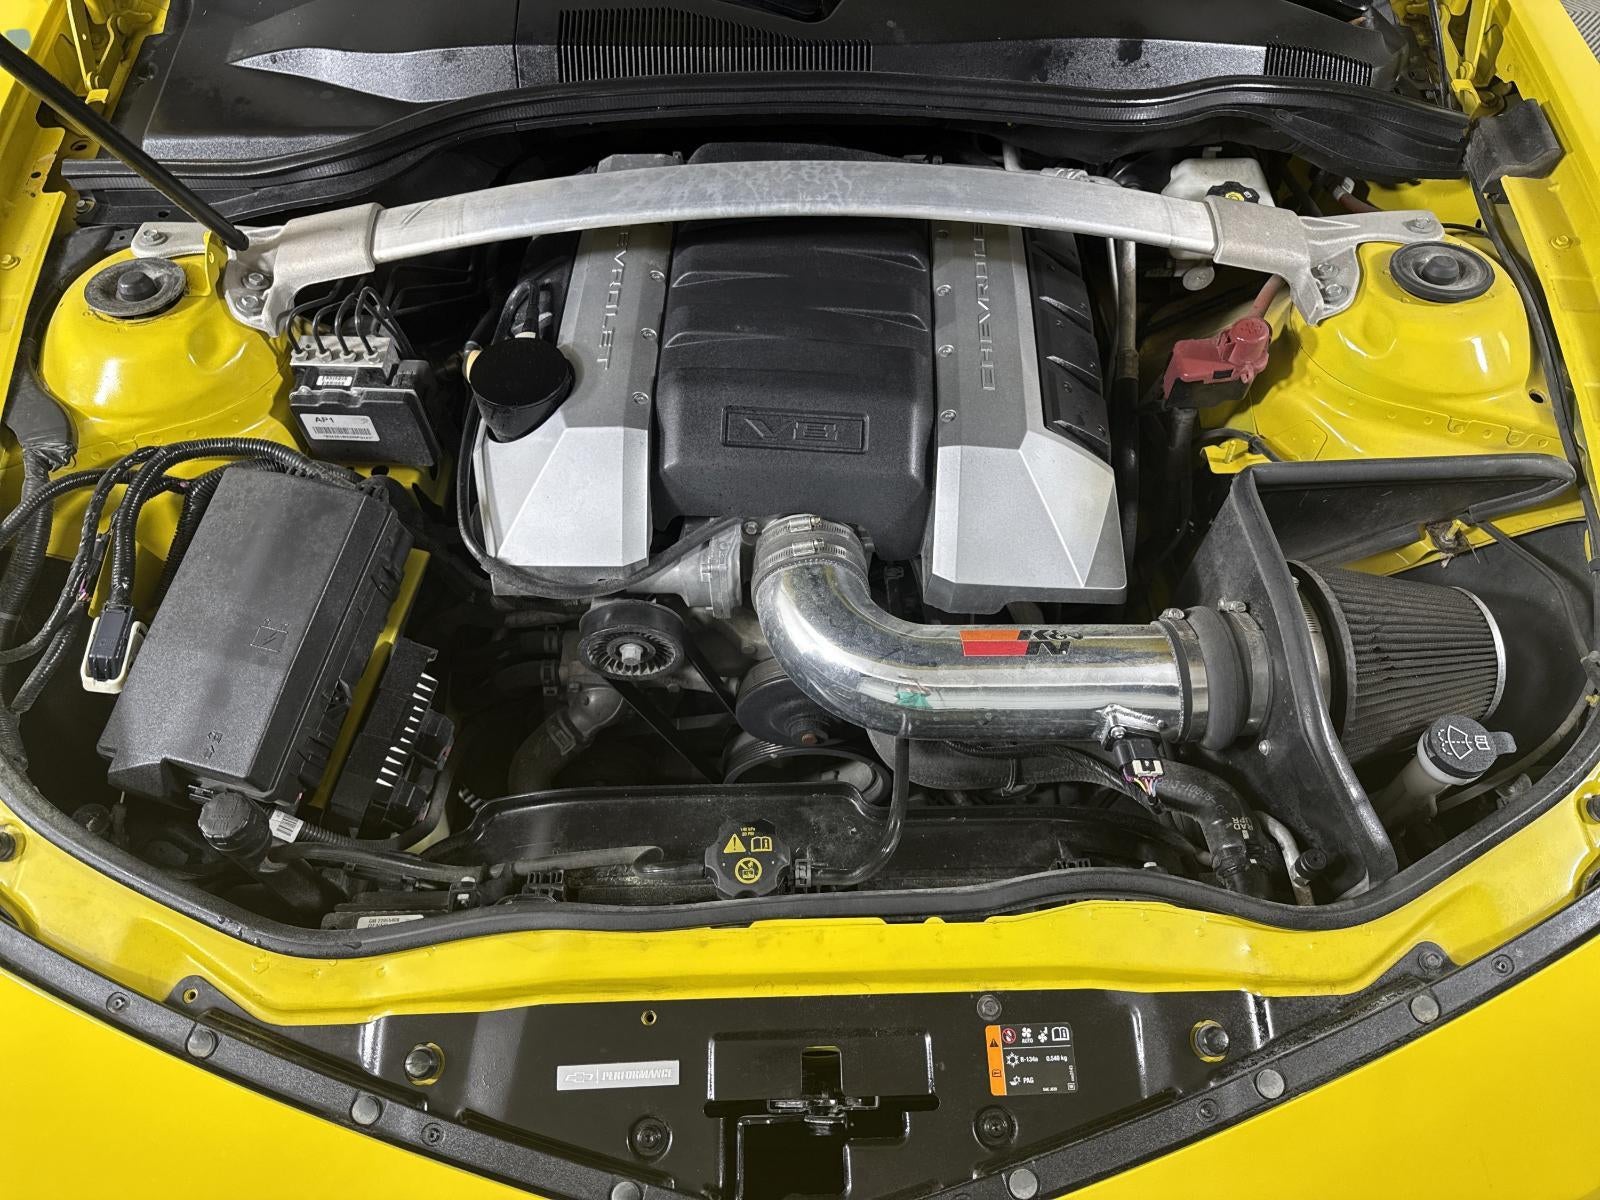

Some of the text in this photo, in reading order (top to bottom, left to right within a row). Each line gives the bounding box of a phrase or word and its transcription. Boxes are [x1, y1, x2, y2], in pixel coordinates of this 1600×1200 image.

[597, 232, 629, 371] EVROLET
[972, 223, 996, 391] CHEVROLE
[602, 1068, 673, 1081] PERFORMANCE
